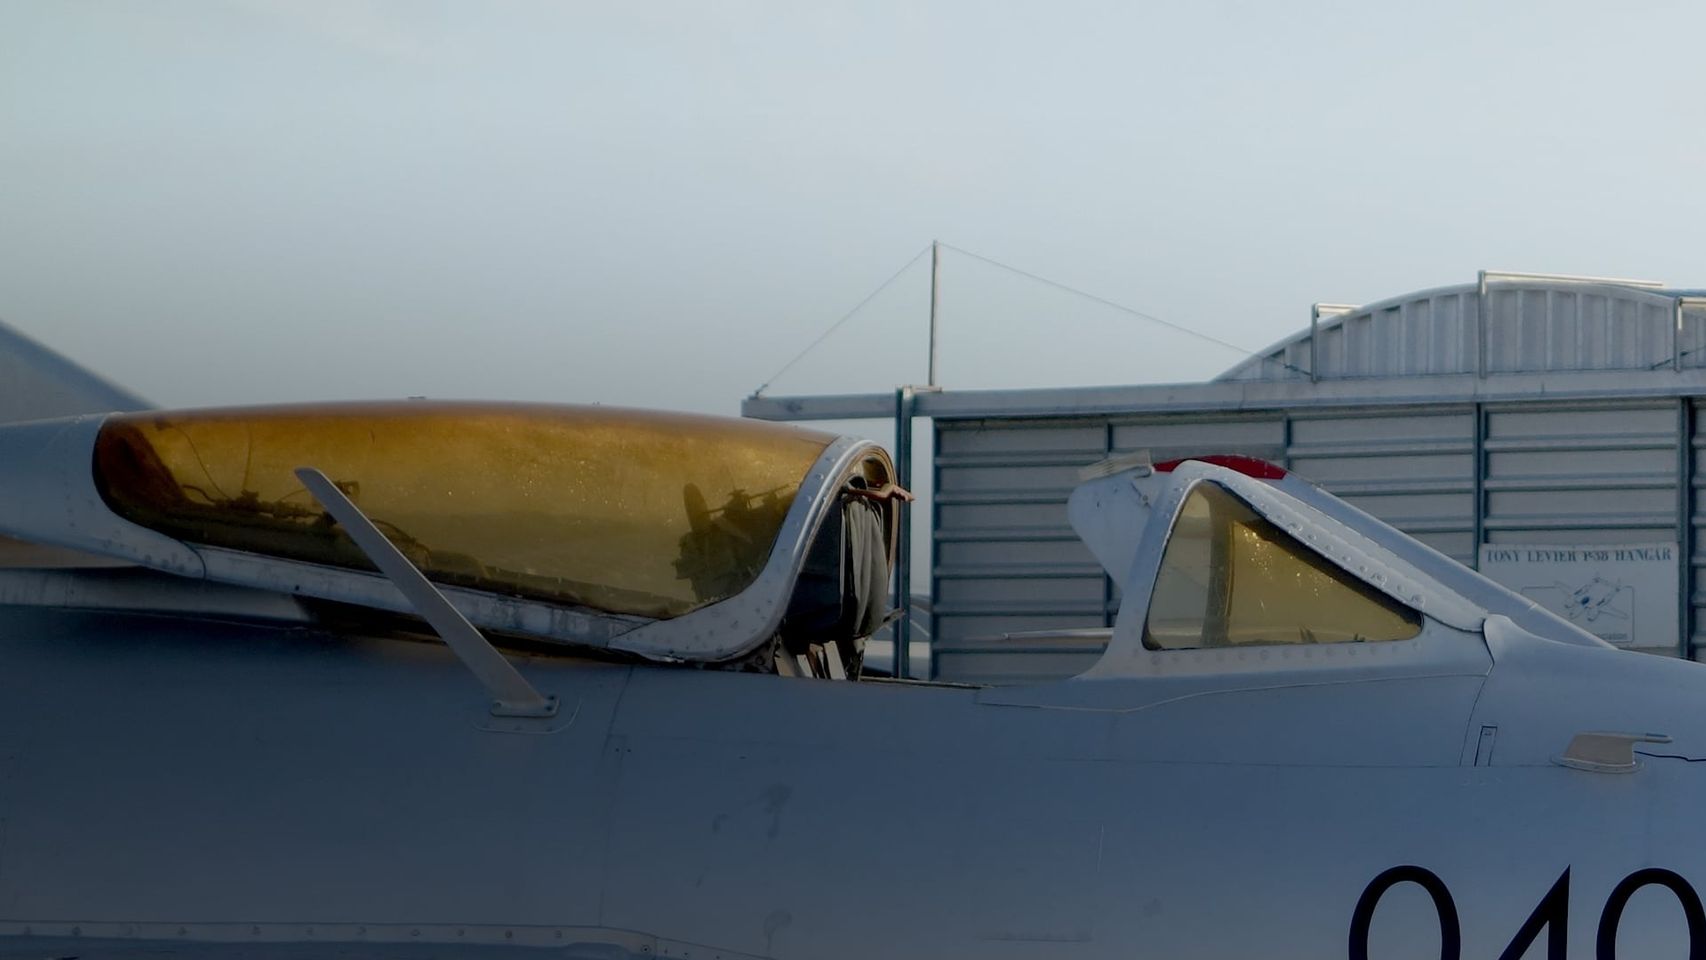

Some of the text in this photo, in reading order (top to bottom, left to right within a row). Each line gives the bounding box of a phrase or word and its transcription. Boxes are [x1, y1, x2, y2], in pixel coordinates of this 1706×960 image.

[1487, 548, 1672, 562] TONY LEVIER P-38 HANGAR
